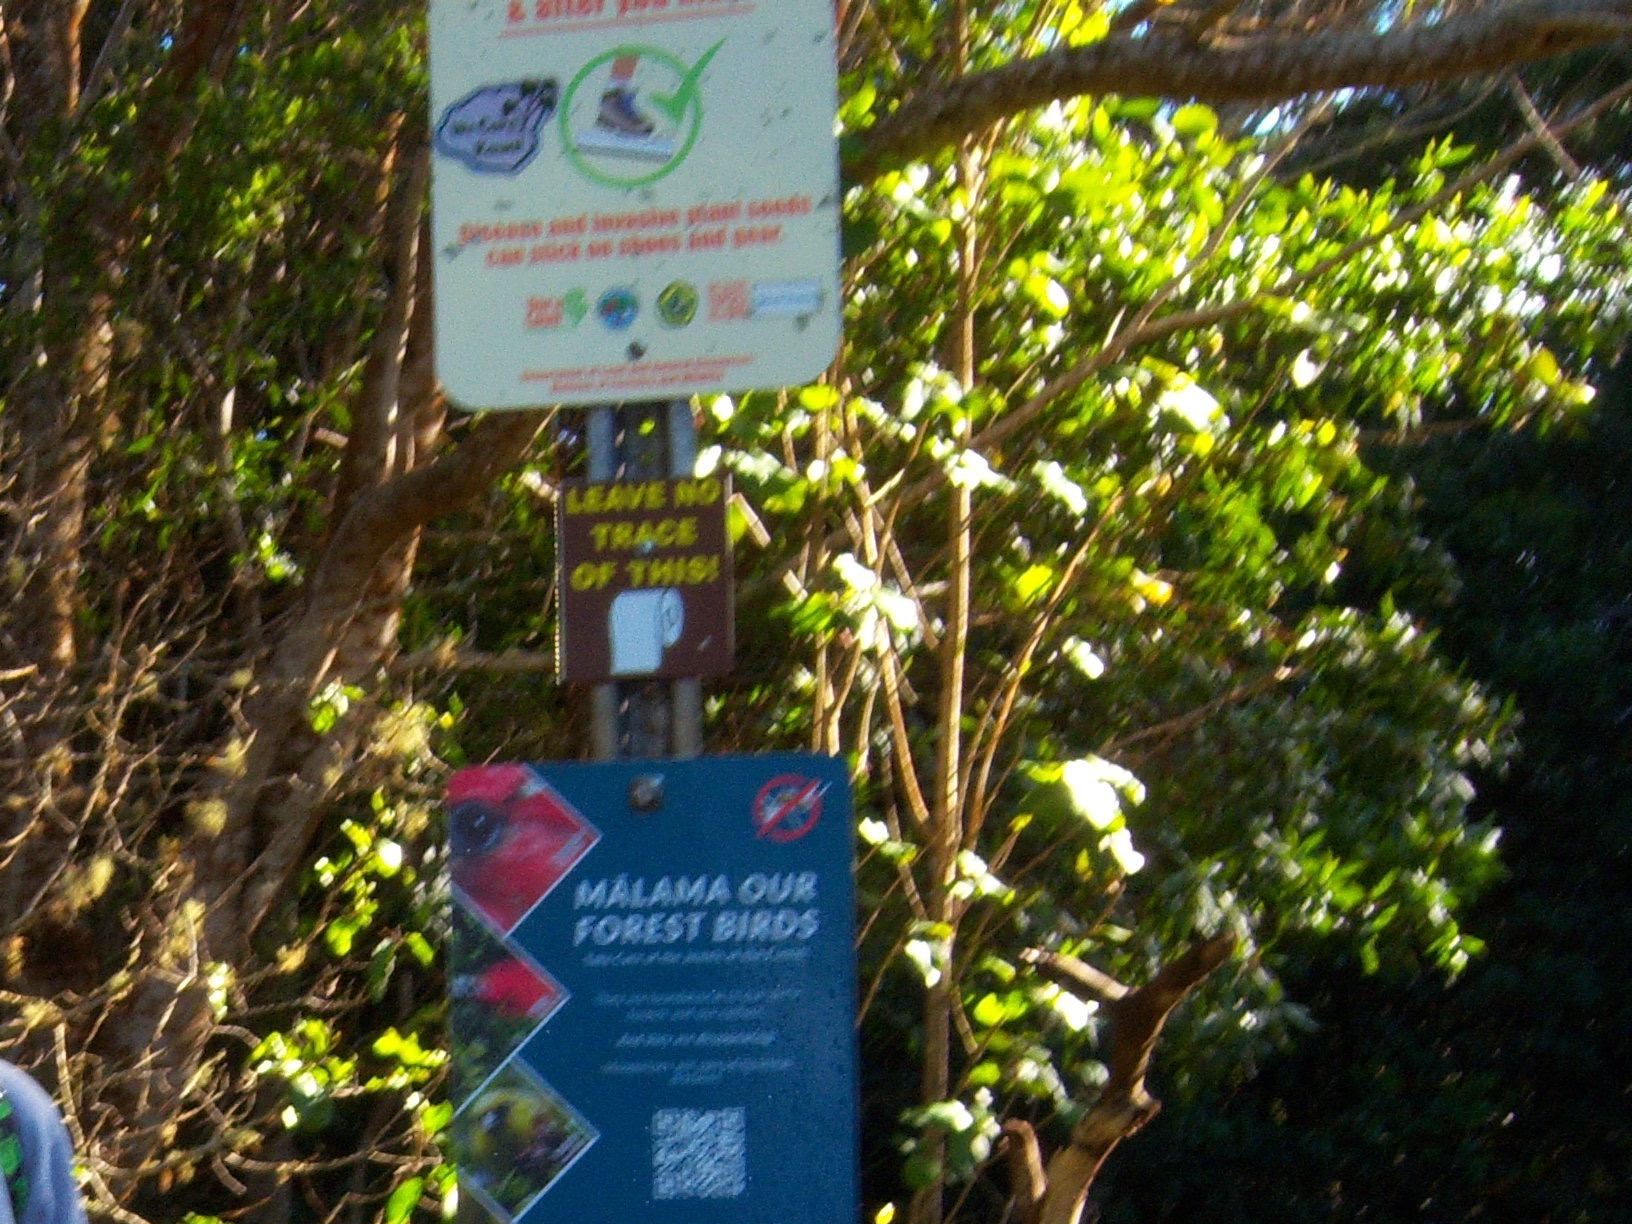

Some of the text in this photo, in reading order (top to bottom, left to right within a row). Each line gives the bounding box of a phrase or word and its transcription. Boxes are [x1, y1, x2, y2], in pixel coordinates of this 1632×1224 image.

[566, 478, 721, 515] LEAVE NO
[590, 516, 699, 552] TRACE
[570, 555, 720, 591] OF THIS!
[738, 871, 818, 905] OUR
[572, 907, 820, 947] FOREST BIRDS
